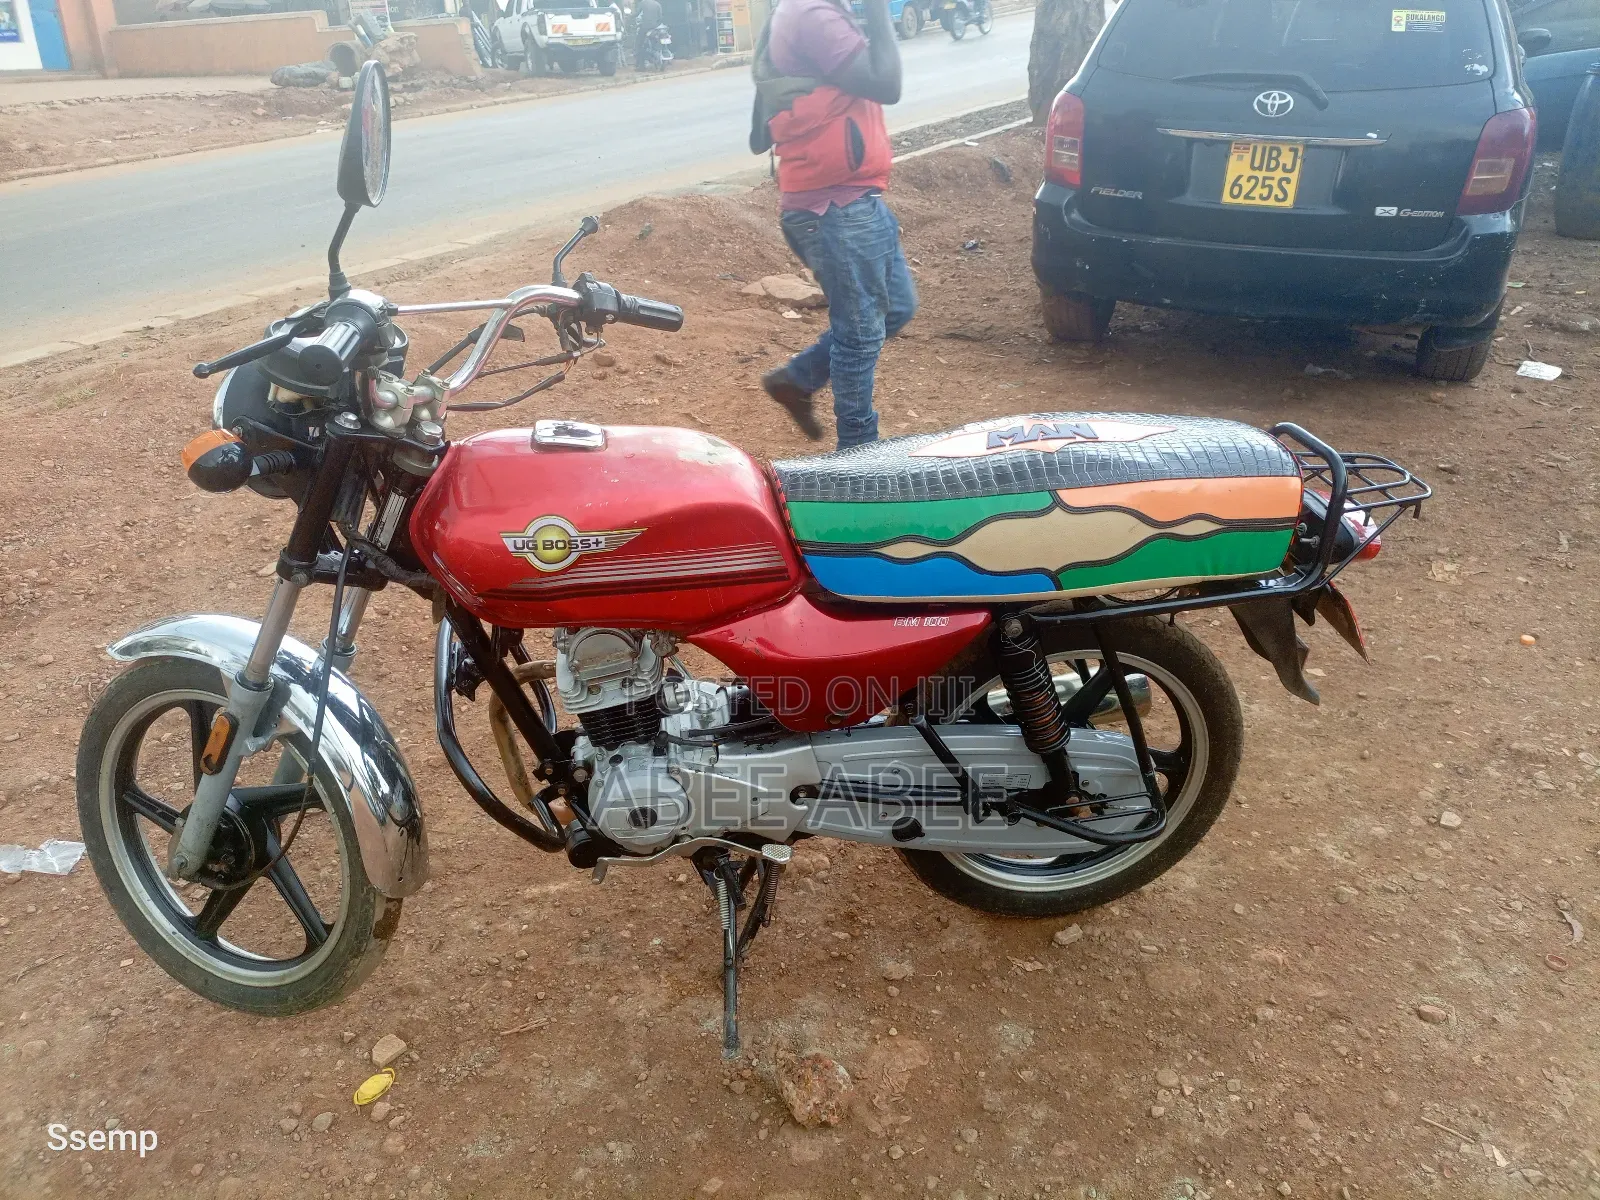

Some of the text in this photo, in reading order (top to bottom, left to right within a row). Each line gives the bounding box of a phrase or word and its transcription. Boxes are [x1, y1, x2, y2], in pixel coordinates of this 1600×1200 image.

[1250, 145, 1299, 173] UBJ
[1090, 186, 1143, 200] FIELDER
[1229, 175, 1292, 203] 625S
[986, 422, 1100, 450] MAN
[513, 537, 603, 551] UG BOSS+
